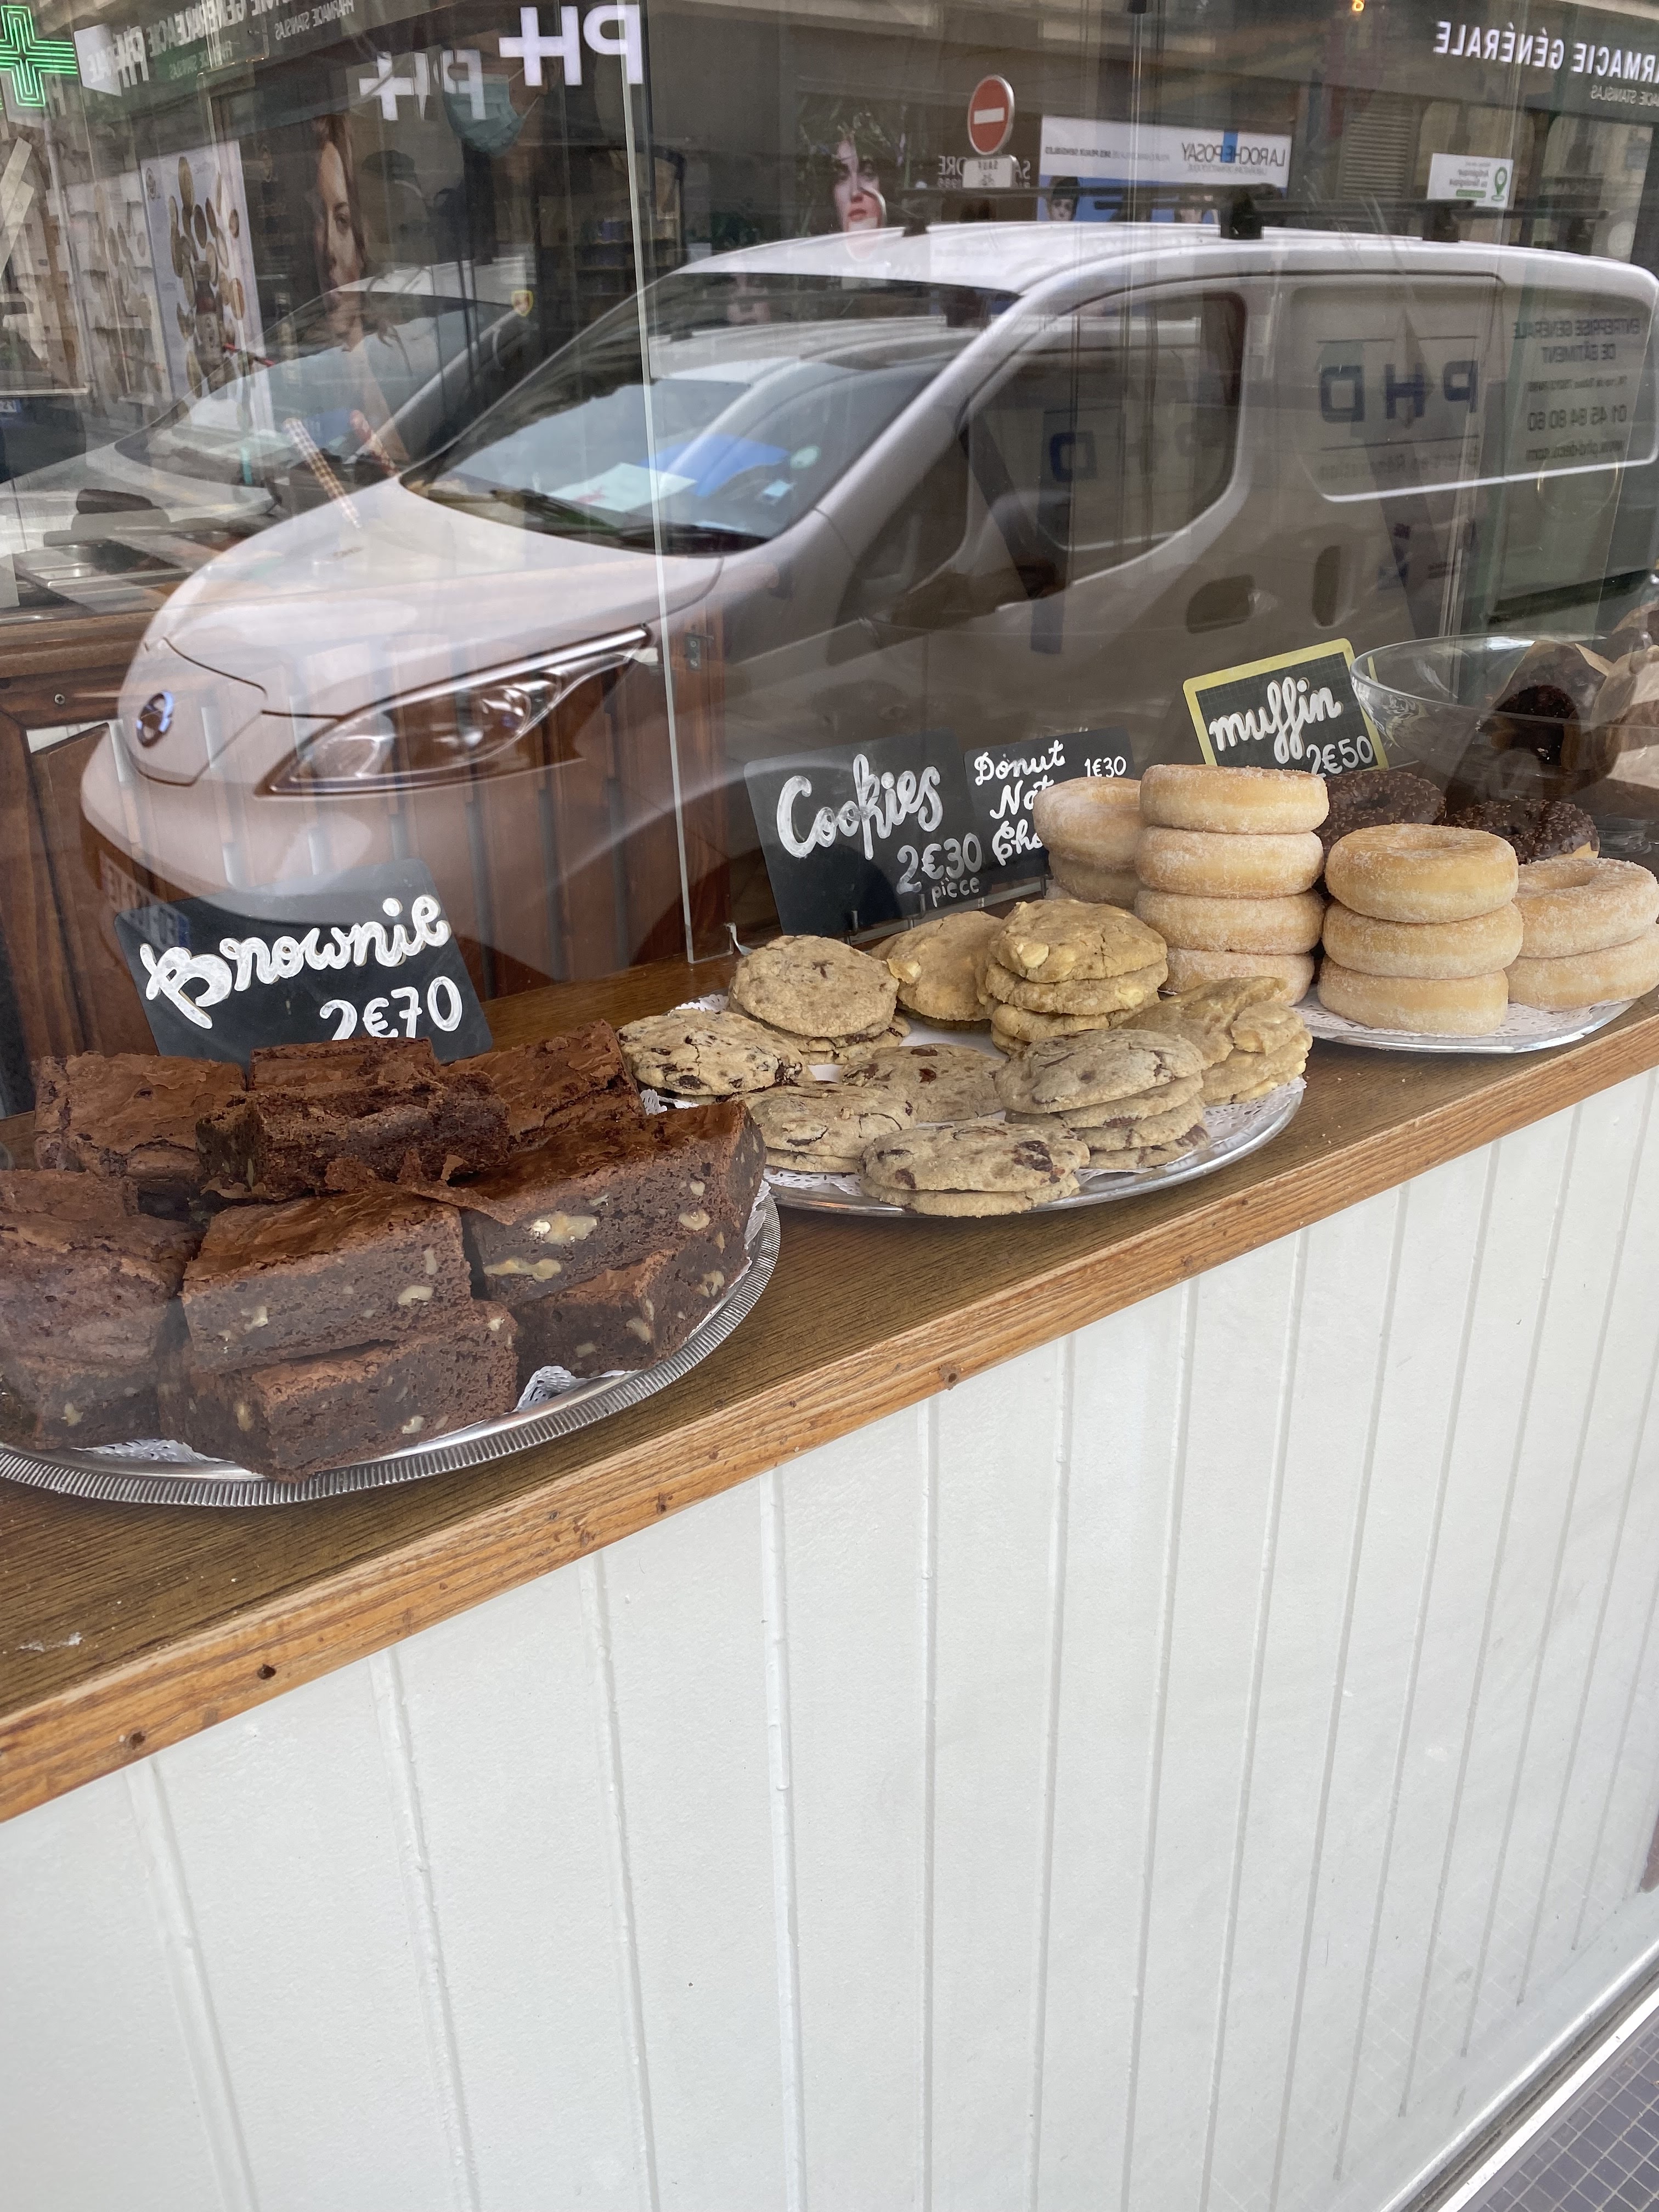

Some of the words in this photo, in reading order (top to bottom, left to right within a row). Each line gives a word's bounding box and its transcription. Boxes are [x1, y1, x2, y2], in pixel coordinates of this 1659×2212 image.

[1208, 675, 1344, 765] muffin
[1085, 755, 1127, 777] 1€30
[1306, 735, 1375, 778] 2€50
[776, 753, 942, 861] Cookies
[896, 832, 983, 895] 2€30
[139, 894, 452, 1030] Brownie
[319, 976, 463, 1041] 2€70
